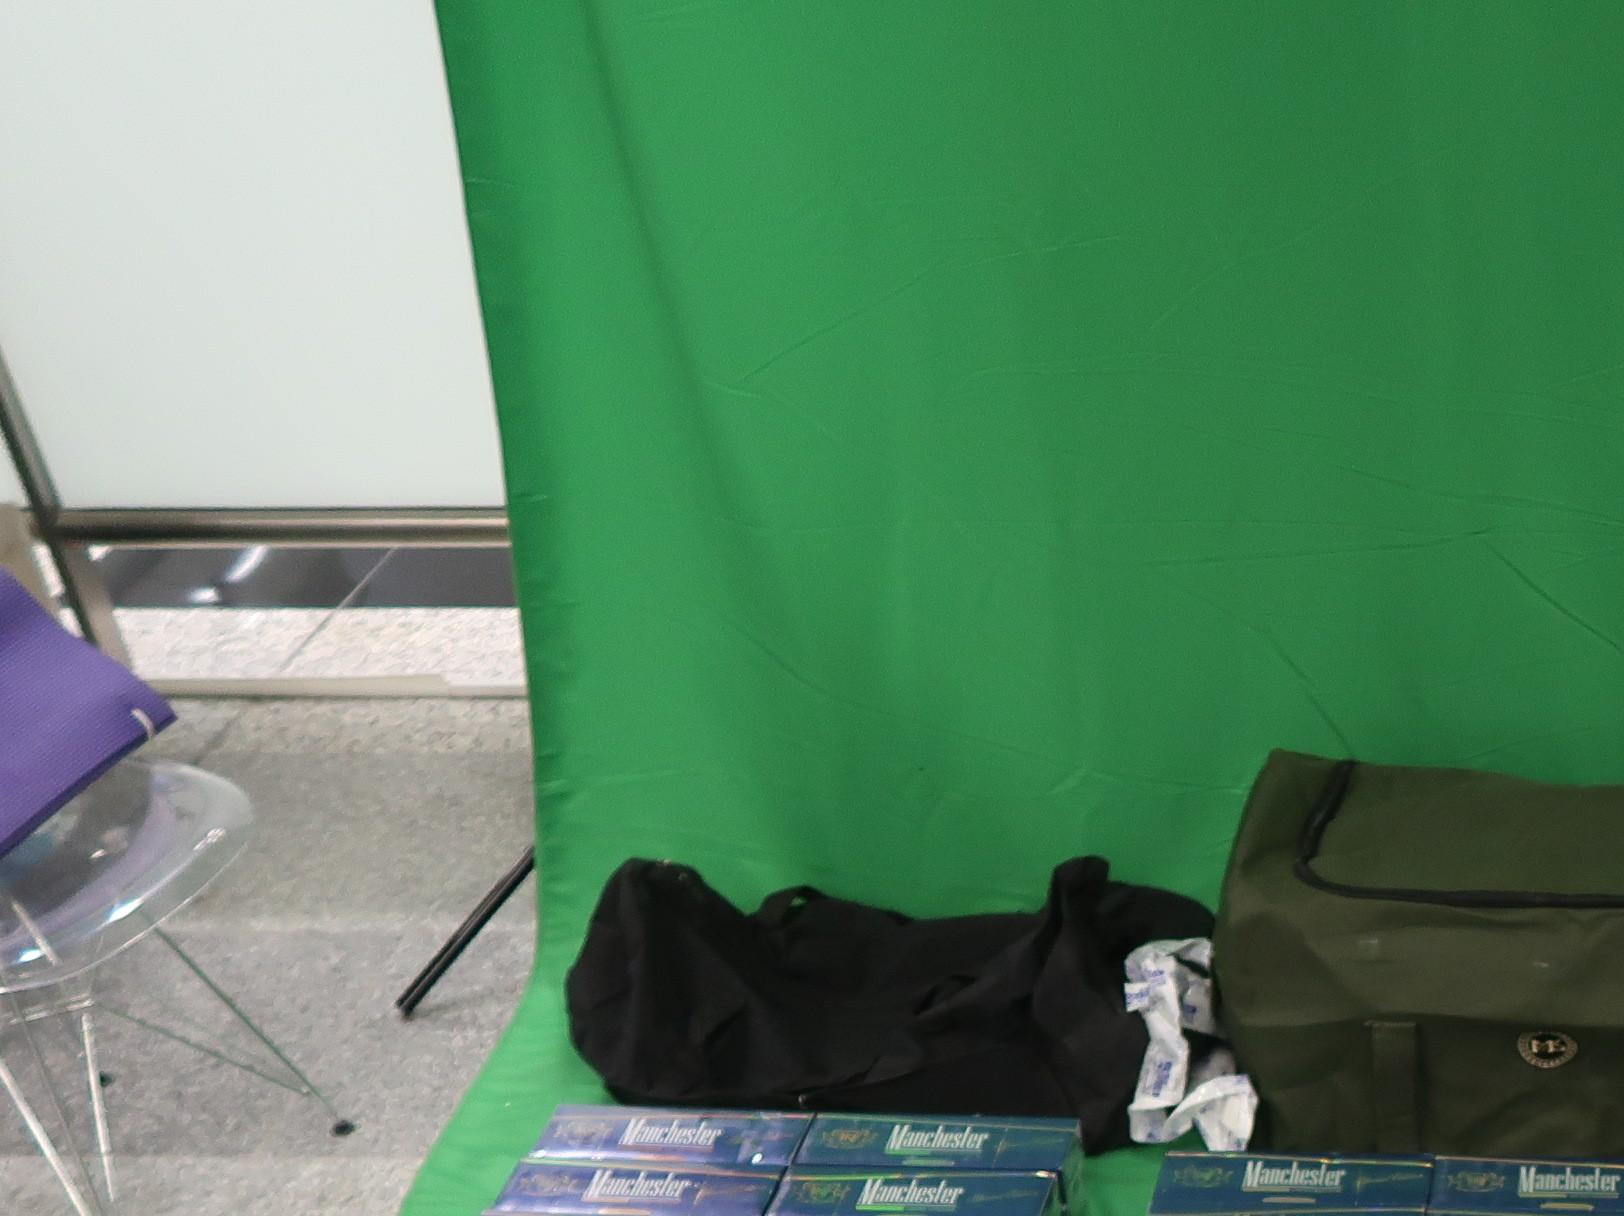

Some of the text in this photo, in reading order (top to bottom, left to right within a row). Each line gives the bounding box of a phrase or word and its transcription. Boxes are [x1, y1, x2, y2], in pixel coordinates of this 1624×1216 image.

[619, 1118, 722, 1146] Manchester
[885, 1124, 989, 1151] Manchester
[582, 1169, 691, 1199] Manchester
[1243, 1161, 1346, 1187] Manchester
[1519, 1166, 1621, 1192] Manchester
[856, 1177, 964, 1205] Manchester
